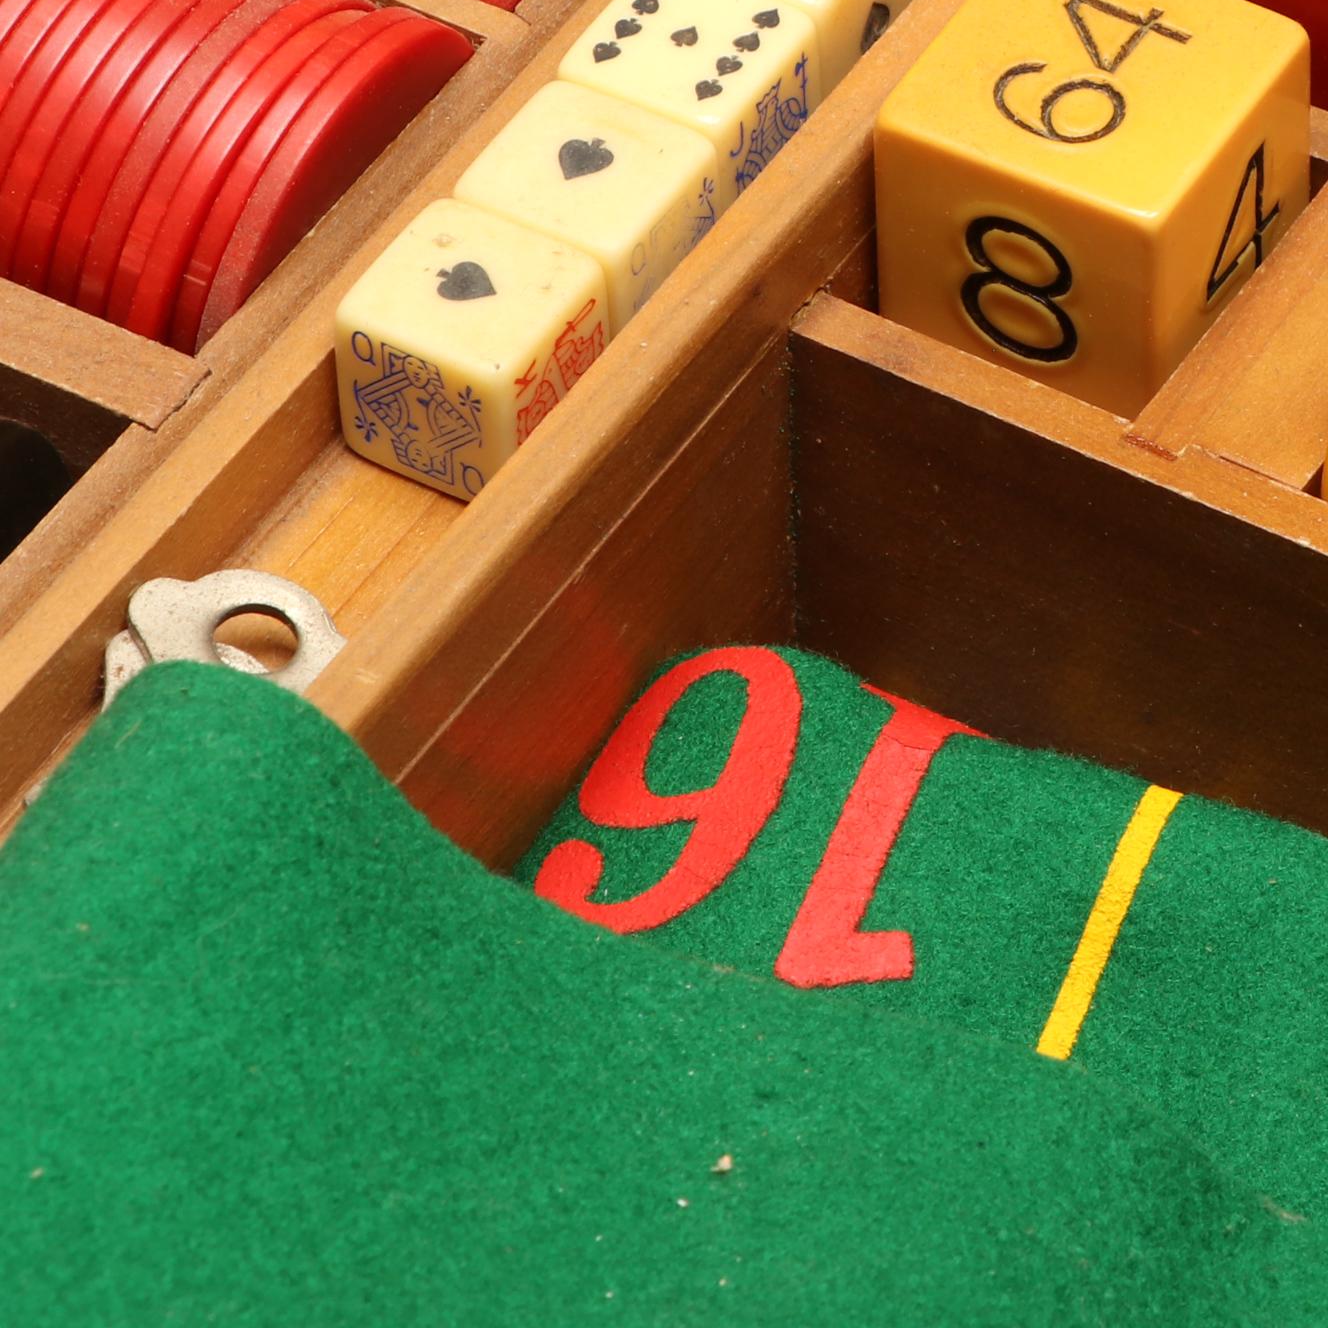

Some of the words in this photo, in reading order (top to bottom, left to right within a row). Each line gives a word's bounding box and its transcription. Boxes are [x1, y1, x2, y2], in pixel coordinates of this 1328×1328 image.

[729, 120, 743, 158] J
[1206, 141, 1281, 305] 4
[959, 215, 1079, 363] 8
[351, 330, 376, 367] Q
[513, 357, 537, 399] K
[459, 462, 485, 498] Q
[533, 644, 994, 989] 16
